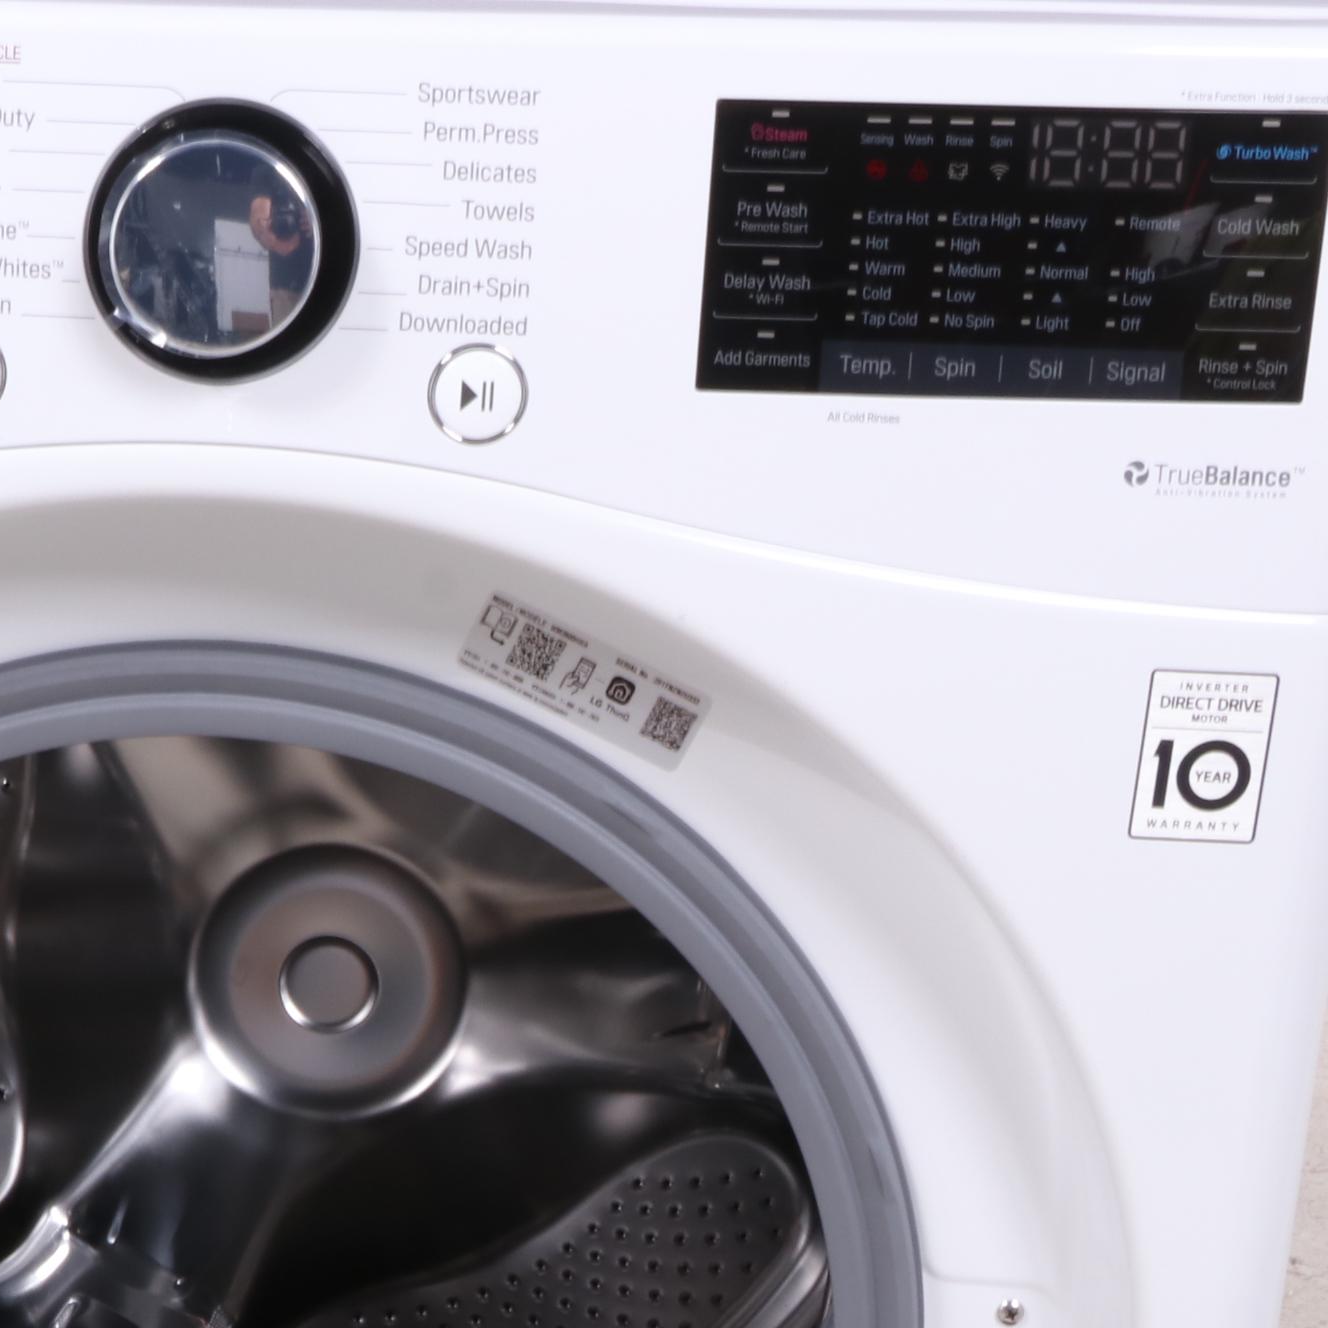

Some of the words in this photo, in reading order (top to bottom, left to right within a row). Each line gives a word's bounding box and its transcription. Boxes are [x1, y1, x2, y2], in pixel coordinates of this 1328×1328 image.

[418, 82, 541, 108] Sportswear
[424, 121, 538, 145] Perm.Press
[765, 128, 808, 141] Steam
[860, 134, 894, 147] Sensing
[904, 134, 934, 146] Wash
[946, 135, 974, 147] Rinse
[990, 136, 1013, 148] Spin
[752, 147, 780, 159] Fresh
[782, 148, 807, 160] Care
[443, 160, 537, 184] Delicates
[462, 200, 535, 222] Towels
[737, 201, 761, 217] Pre
[766, 202, 808, 218] Wash
[867, 211, 903, 225] Extra
[906, 212, 929, 226] Hot
[952, 213, 987, 227] Extra
[991, 214, 1021, 230] High
[1044, 214, 1087, 232] Heavy
[1130, 216, 1181, 231] Remote
[741, 221, 780, 233] Remote
[782, 222, 808, 234] Start
[1217, 218, 1252, 235] Cold
[1255, 219, 1299, 236] Wash
[405, 235, 468, 261] Speed
[475, 238, 532, 260] Wash
[865, 236, 889, 250] Hot
[950, 238, 980, 255] High
[865, 261, 905, 275] Warm
[948, 263, 1001, 278] Medium
[1040, 265, 1089, 280] Normal
[1125, 267, 1155, 284] High
[418, 274, 530, 301] Drain+Spin
[724, 273, 765, 291] Delay
[769, 274, 811, 291] Wash
[862, 287, 892, 301] Cold
[946, 289, 975, 302] Low
[1123, 293, 1152, 307] Low
[1209, 292, 1248, 309] Extra
[1252, 293, 1292, 310] Rinse
[399, 311, 528, 336] Downloaded
[862, 312, 885, 328] Tap
[888, 313, 918, 326] Cold
[944, 314, 962, 327] No
[966, 315, 994, 330] Spin
[1036, 316, 1069, 333] Light
[1121, 317, 1141, 332] Off
[714, 350, 742, 366] Add
[745, 351, 811, 368] Garments
[840, 354, 896, 379] Temp.
[934, 356, 976, 381] Spin
[1028, 359, 1063, 380] Soil
[1107, 361, 1166, 385] Signal
[1199, 358, 1238, 374] Rinse
[1242, 362, 1251, 372] +
[1256, 359, 1288, 377] Spin
[1213, 378, 1250, 389] Control
[1253, 379, 1276, 391] Lock
[827, 411, 841, 422] All
[843, 412, 865, 423] Cold
[867, 412, 900, 424] Rinses
[1180, 682, 1249, 693] INVERTER
[590, 696, 603, 708] LG
[1160, 695, 1215, 711] DIRECT
[1218, 698, 1263, 713] DRIVE
[1192, 714, 1228, 724] MOTOR
[1152, 739, 1251, 812] 10
[1195, 771, 1231, 783] YEAR
[1147, 818, 1240, 832] WARRANTY
